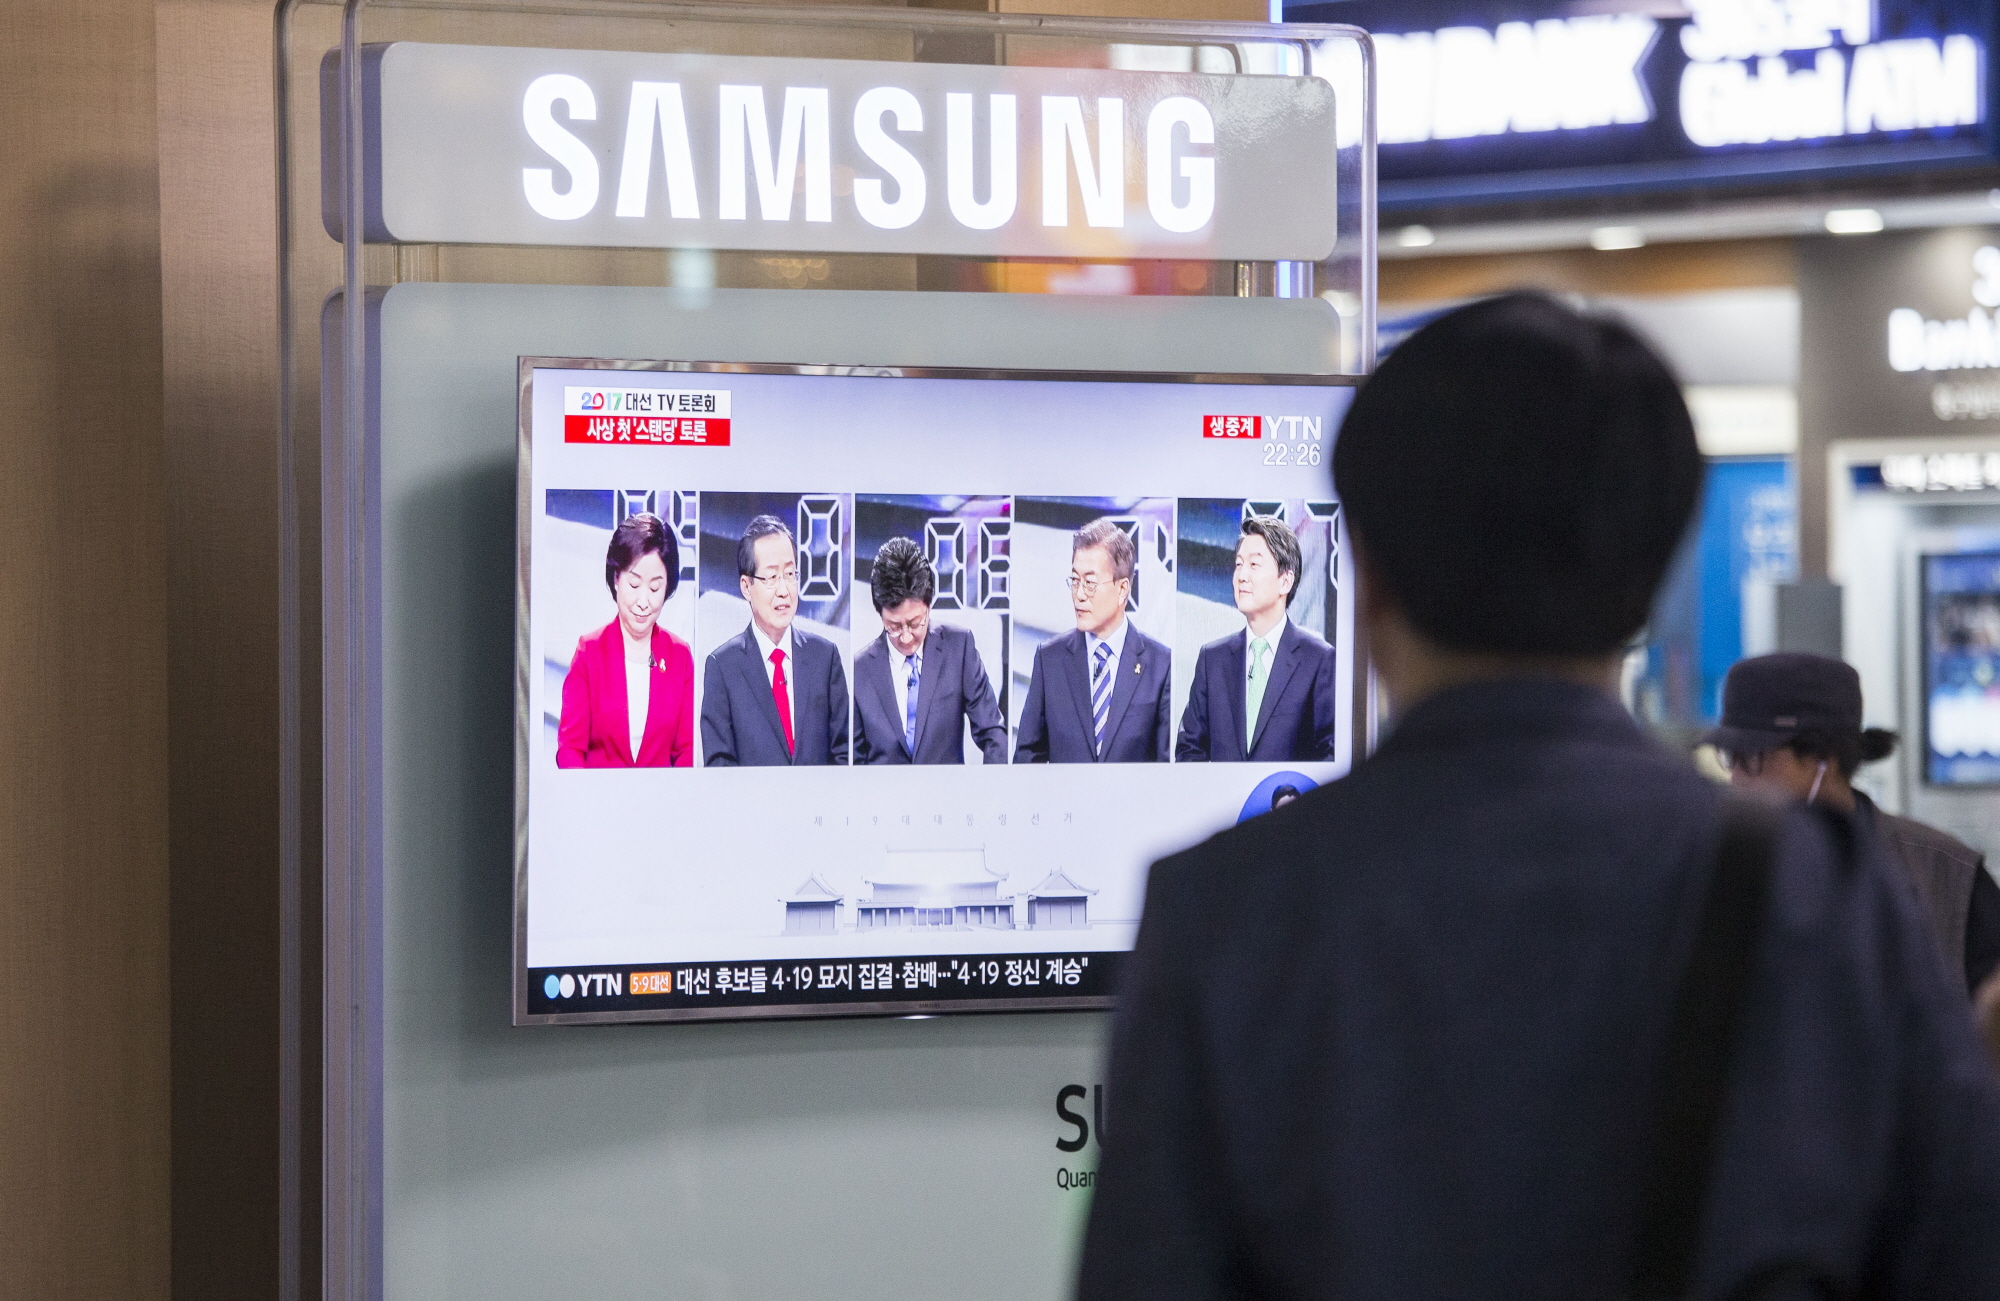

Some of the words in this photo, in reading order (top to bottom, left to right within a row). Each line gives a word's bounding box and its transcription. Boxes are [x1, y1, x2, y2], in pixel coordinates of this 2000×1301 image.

[522, 73, 1216, 233] SAMSUNG
[581, 392, 622, 410] 2017
[626, 393, 652, 411] 대선
[657, 394, 675, 411] TV
[678, 394, 716, 412] 토론회
[586, 418, 615, 440] 사상
[617, 419, 631, 441] 첫
[679, 420, 707, 442] 토론
[1209, 416, 1254, 437] 생중계
[1264, 415, 1322, 440] YTN
[1262, 442, 1321, 466] 22:26
[577, 973, 622, 998] YTN
[676, 968, 710, 995] 대선
[715, 967, 768, 994] 후보들
[771, 966, 813, 991] 4·19
[817, 963, 853, 990] 묘지
[1005, 959, 1040, 986] 정신
